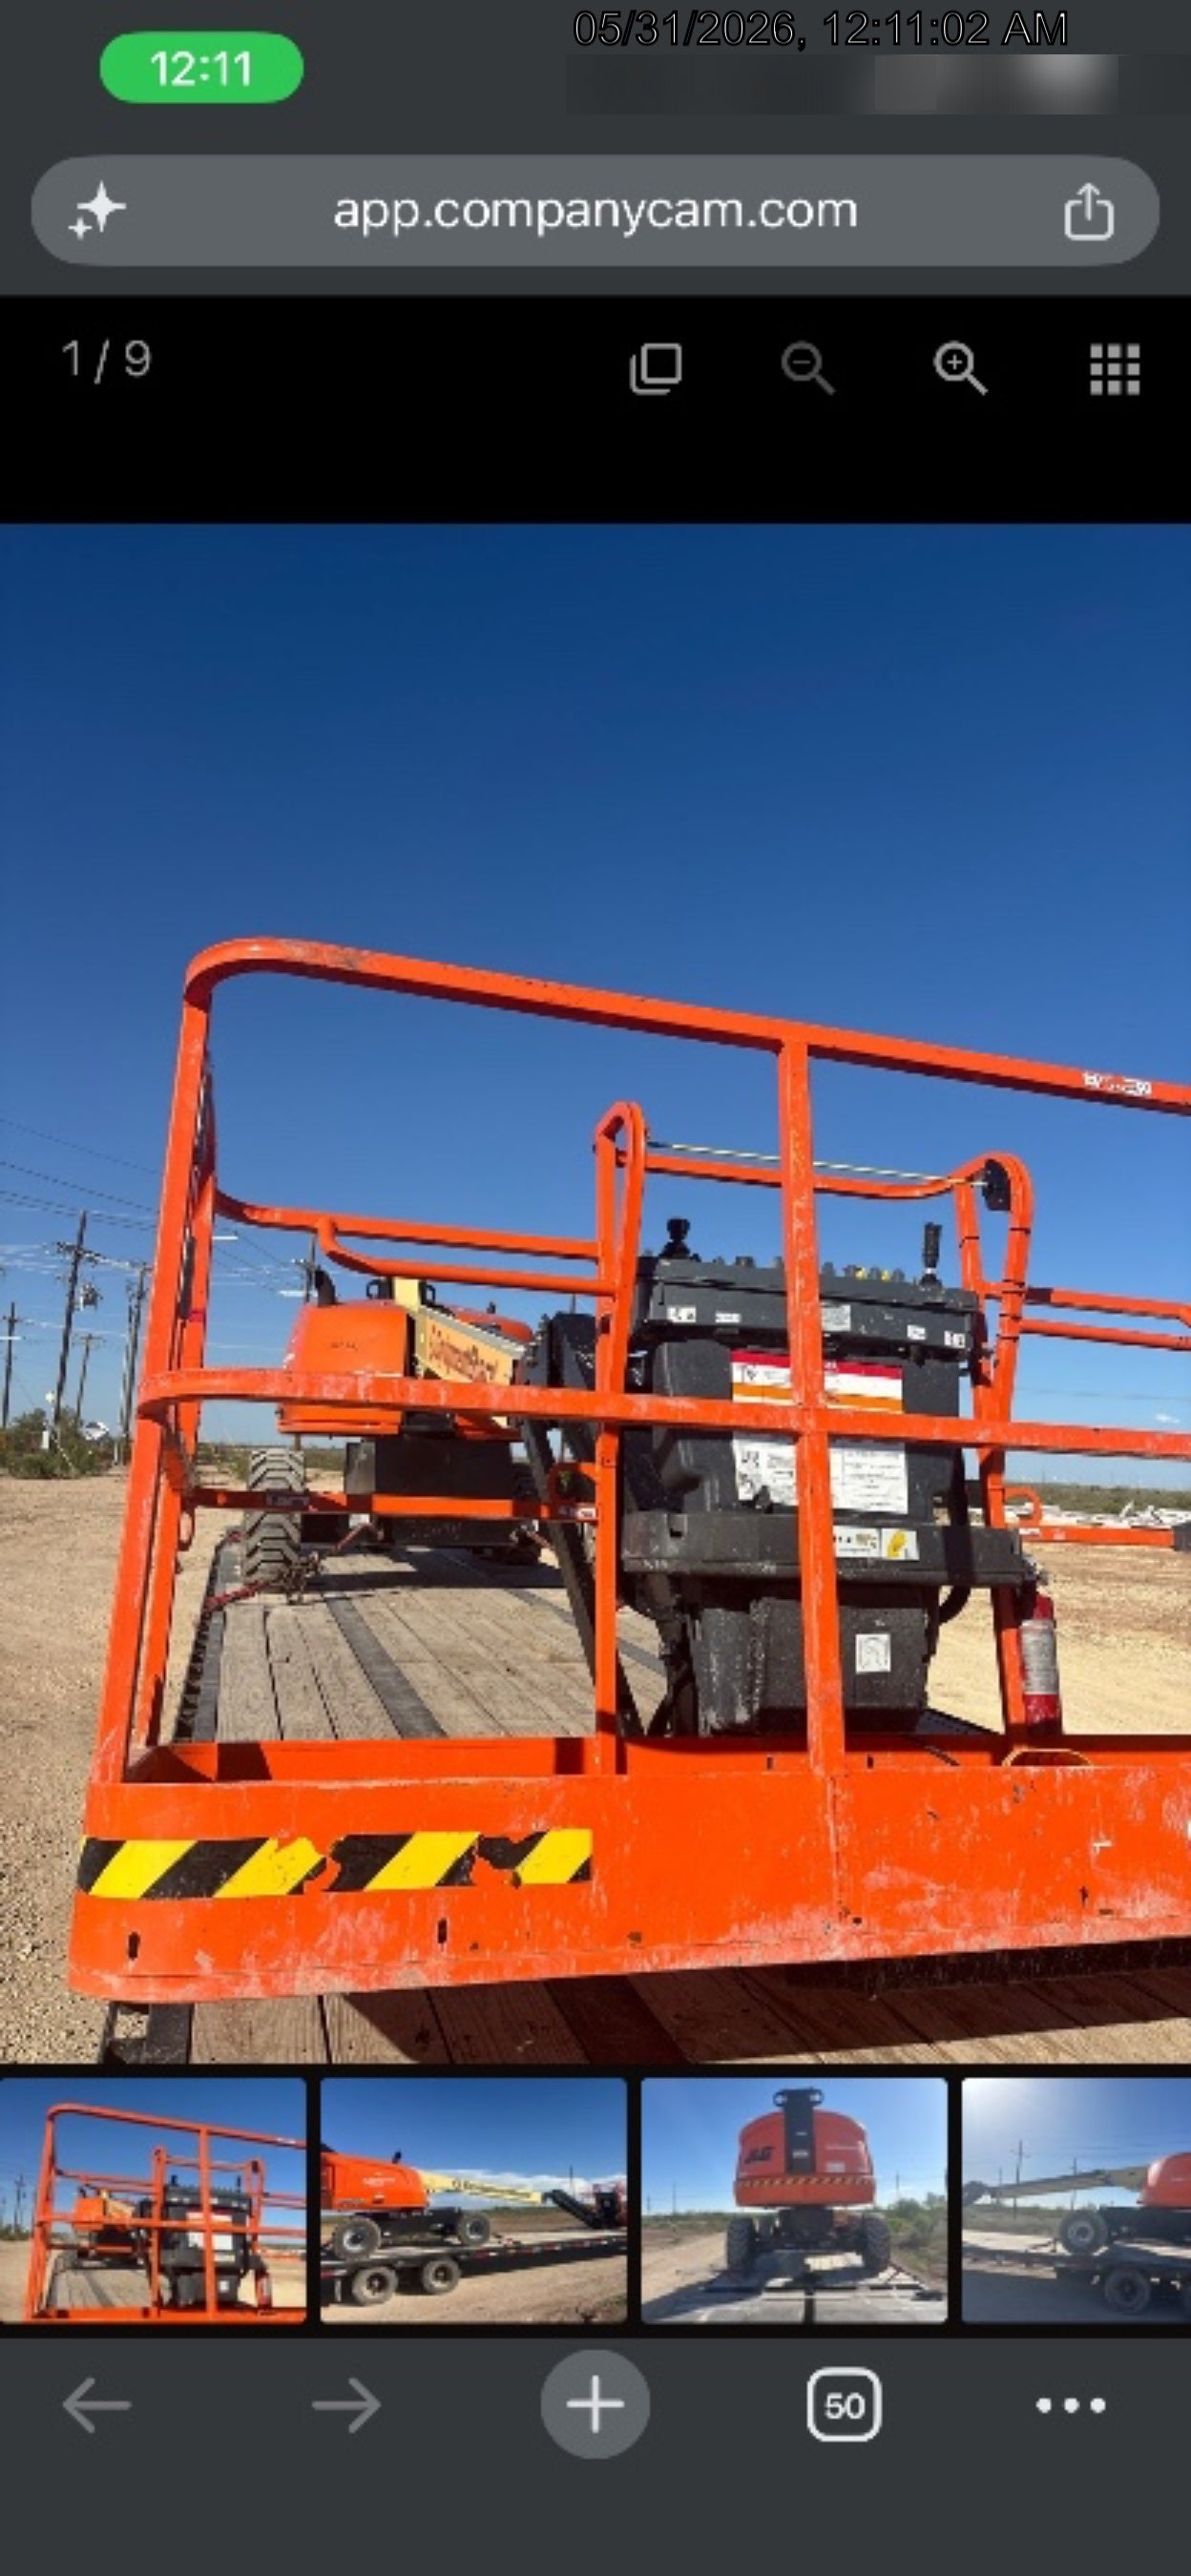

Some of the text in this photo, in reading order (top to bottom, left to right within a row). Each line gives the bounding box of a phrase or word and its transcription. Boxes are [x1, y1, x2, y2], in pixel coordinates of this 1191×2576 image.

[151, 51, 251, 86] 12:11
[333, 196, 857, 239] app.companycam.com
[825, 2392, 866, 2420] 50
